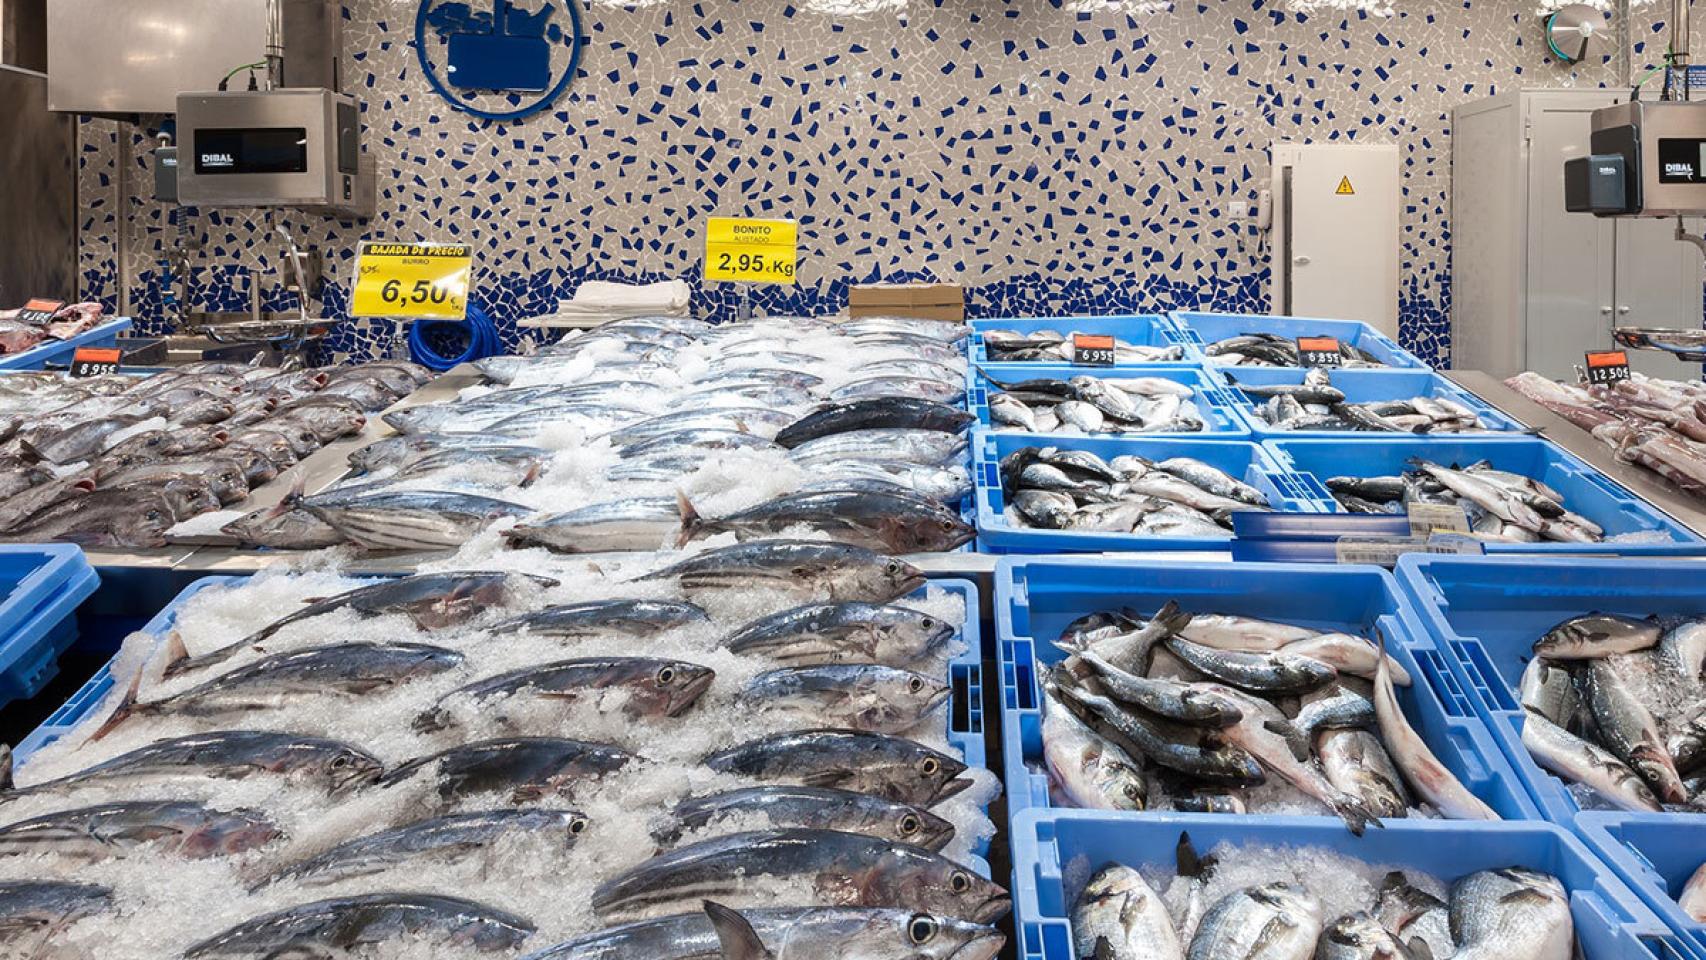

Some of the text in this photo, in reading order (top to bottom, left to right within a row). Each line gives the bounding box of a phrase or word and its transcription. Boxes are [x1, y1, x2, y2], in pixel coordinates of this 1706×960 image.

[202, 153, 234, 163] DIBAL
[1665, 163, 1693, 172] DIBAL
[733, 225, 771, 235] BONITO
[370, 244, 465, 256] BAJADA DE PRECIO
[381, 279, 449, 307] 6,50
